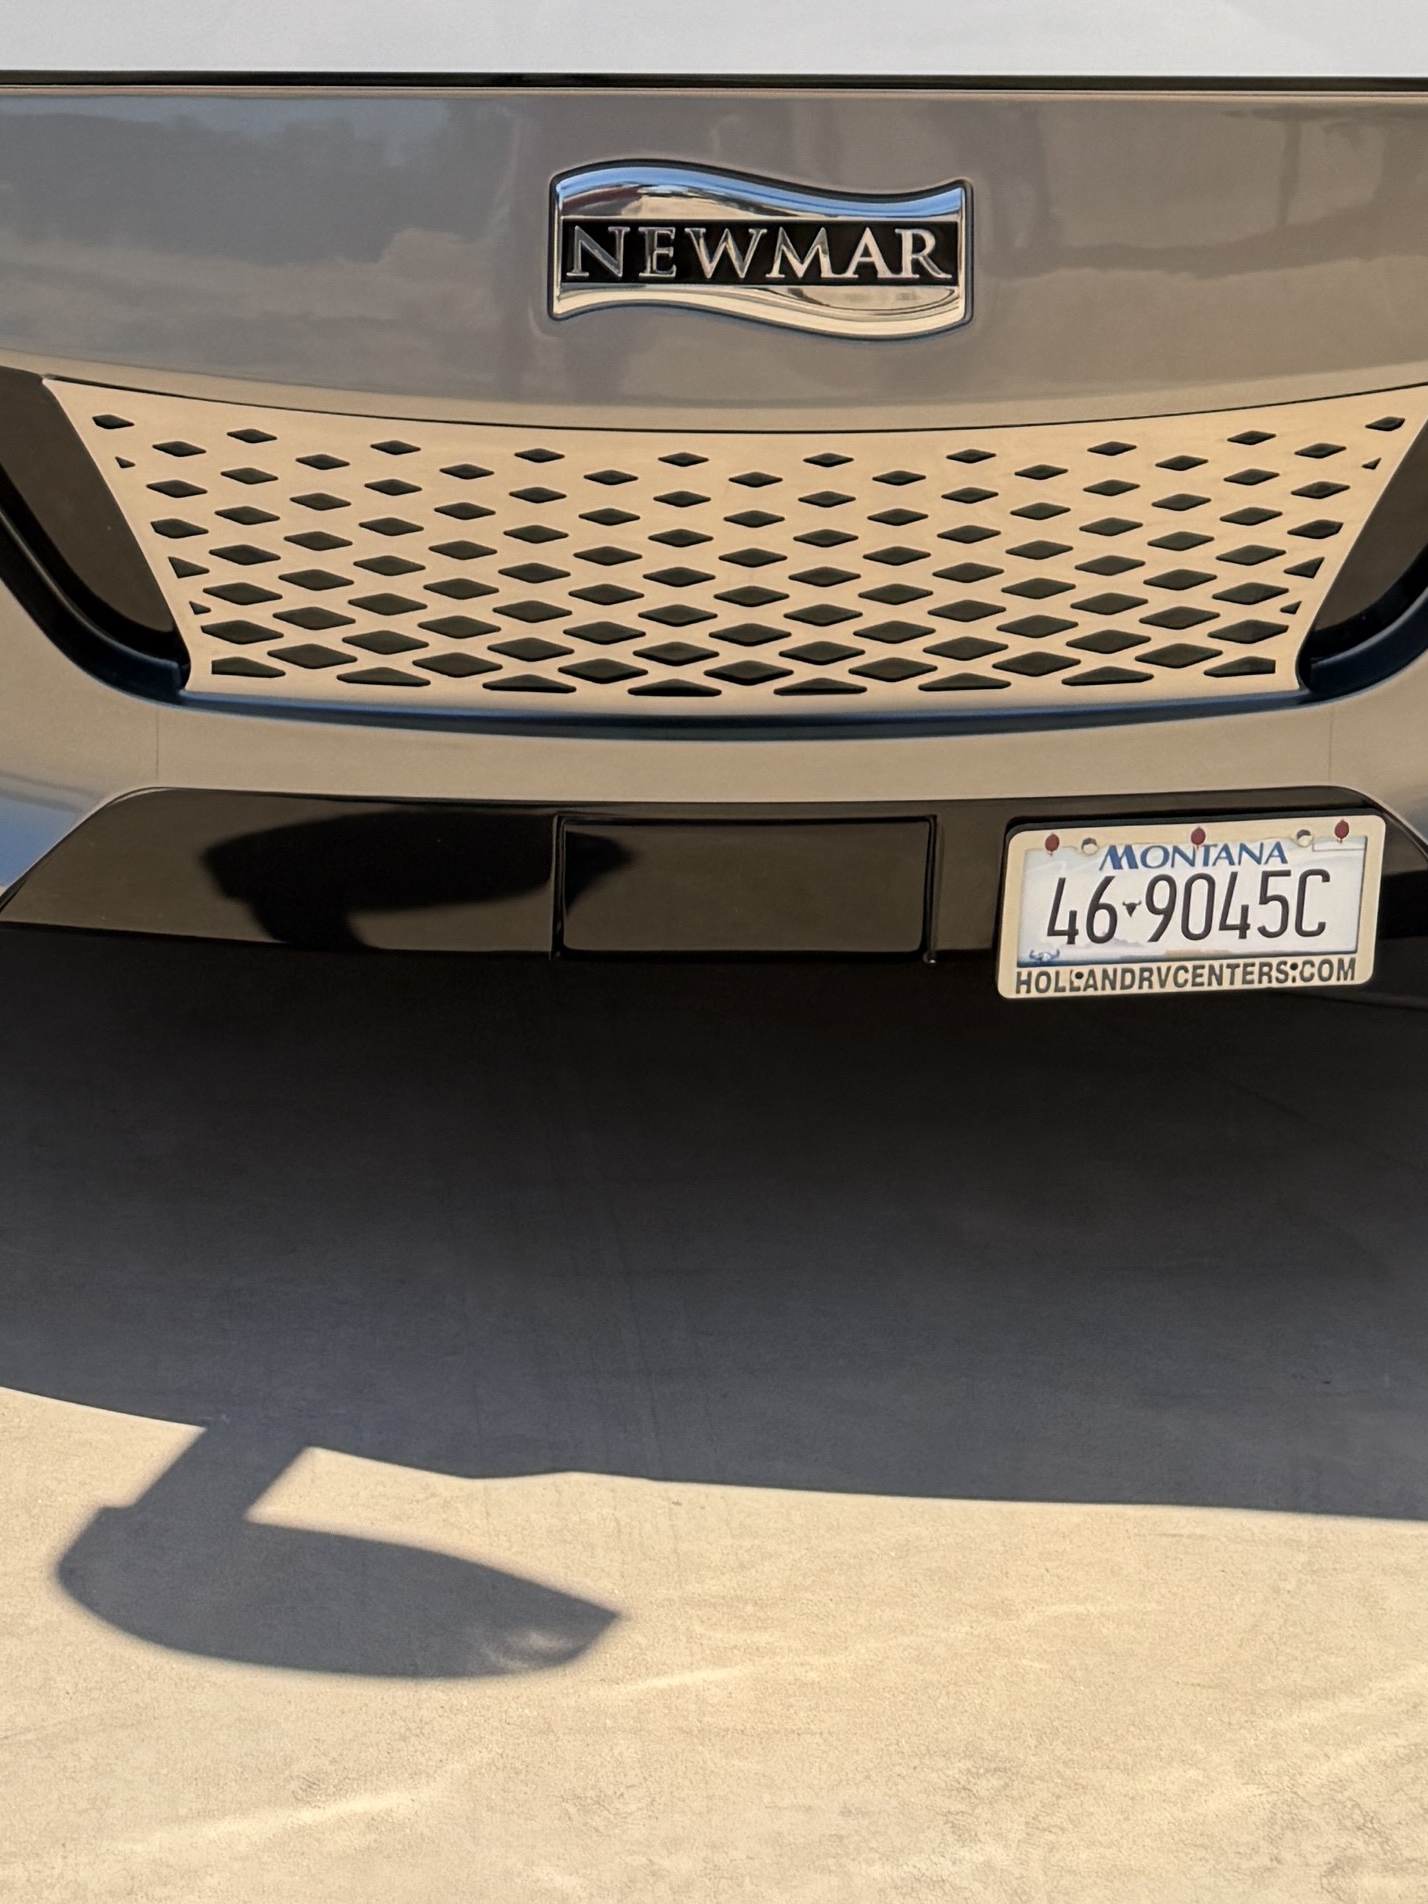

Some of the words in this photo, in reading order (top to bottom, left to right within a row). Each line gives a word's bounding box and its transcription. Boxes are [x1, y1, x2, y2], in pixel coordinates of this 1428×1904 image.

[566, 225, 952, 280] NEWMAR
[1099, 841, 1289, 872] MONTANA
[1015, 957, 1357, 995] HOLLANDRVCENTERS.COM
